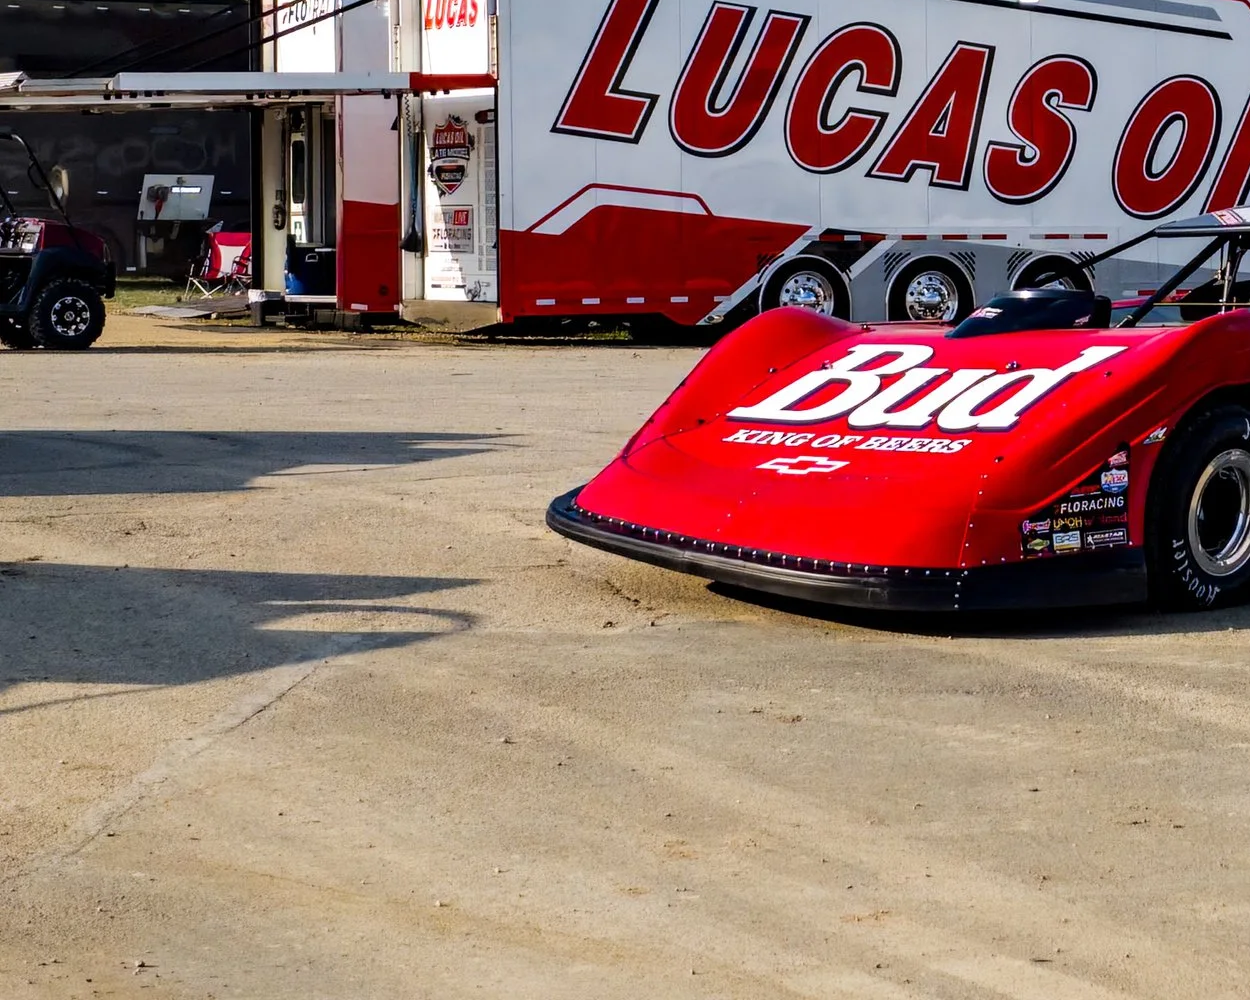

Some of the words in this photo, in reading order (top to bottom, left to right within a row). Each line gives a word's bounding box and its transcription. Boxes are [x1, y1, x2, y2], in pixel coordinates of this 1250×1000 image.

[726, 343, 1128, 434] Bud
[722, 429, 812, 447] KING
[811, 434, 863, 448] OF
[855, 436, 972, 454] BEERS
[1060, 496, 1125, 514] FLORACING
